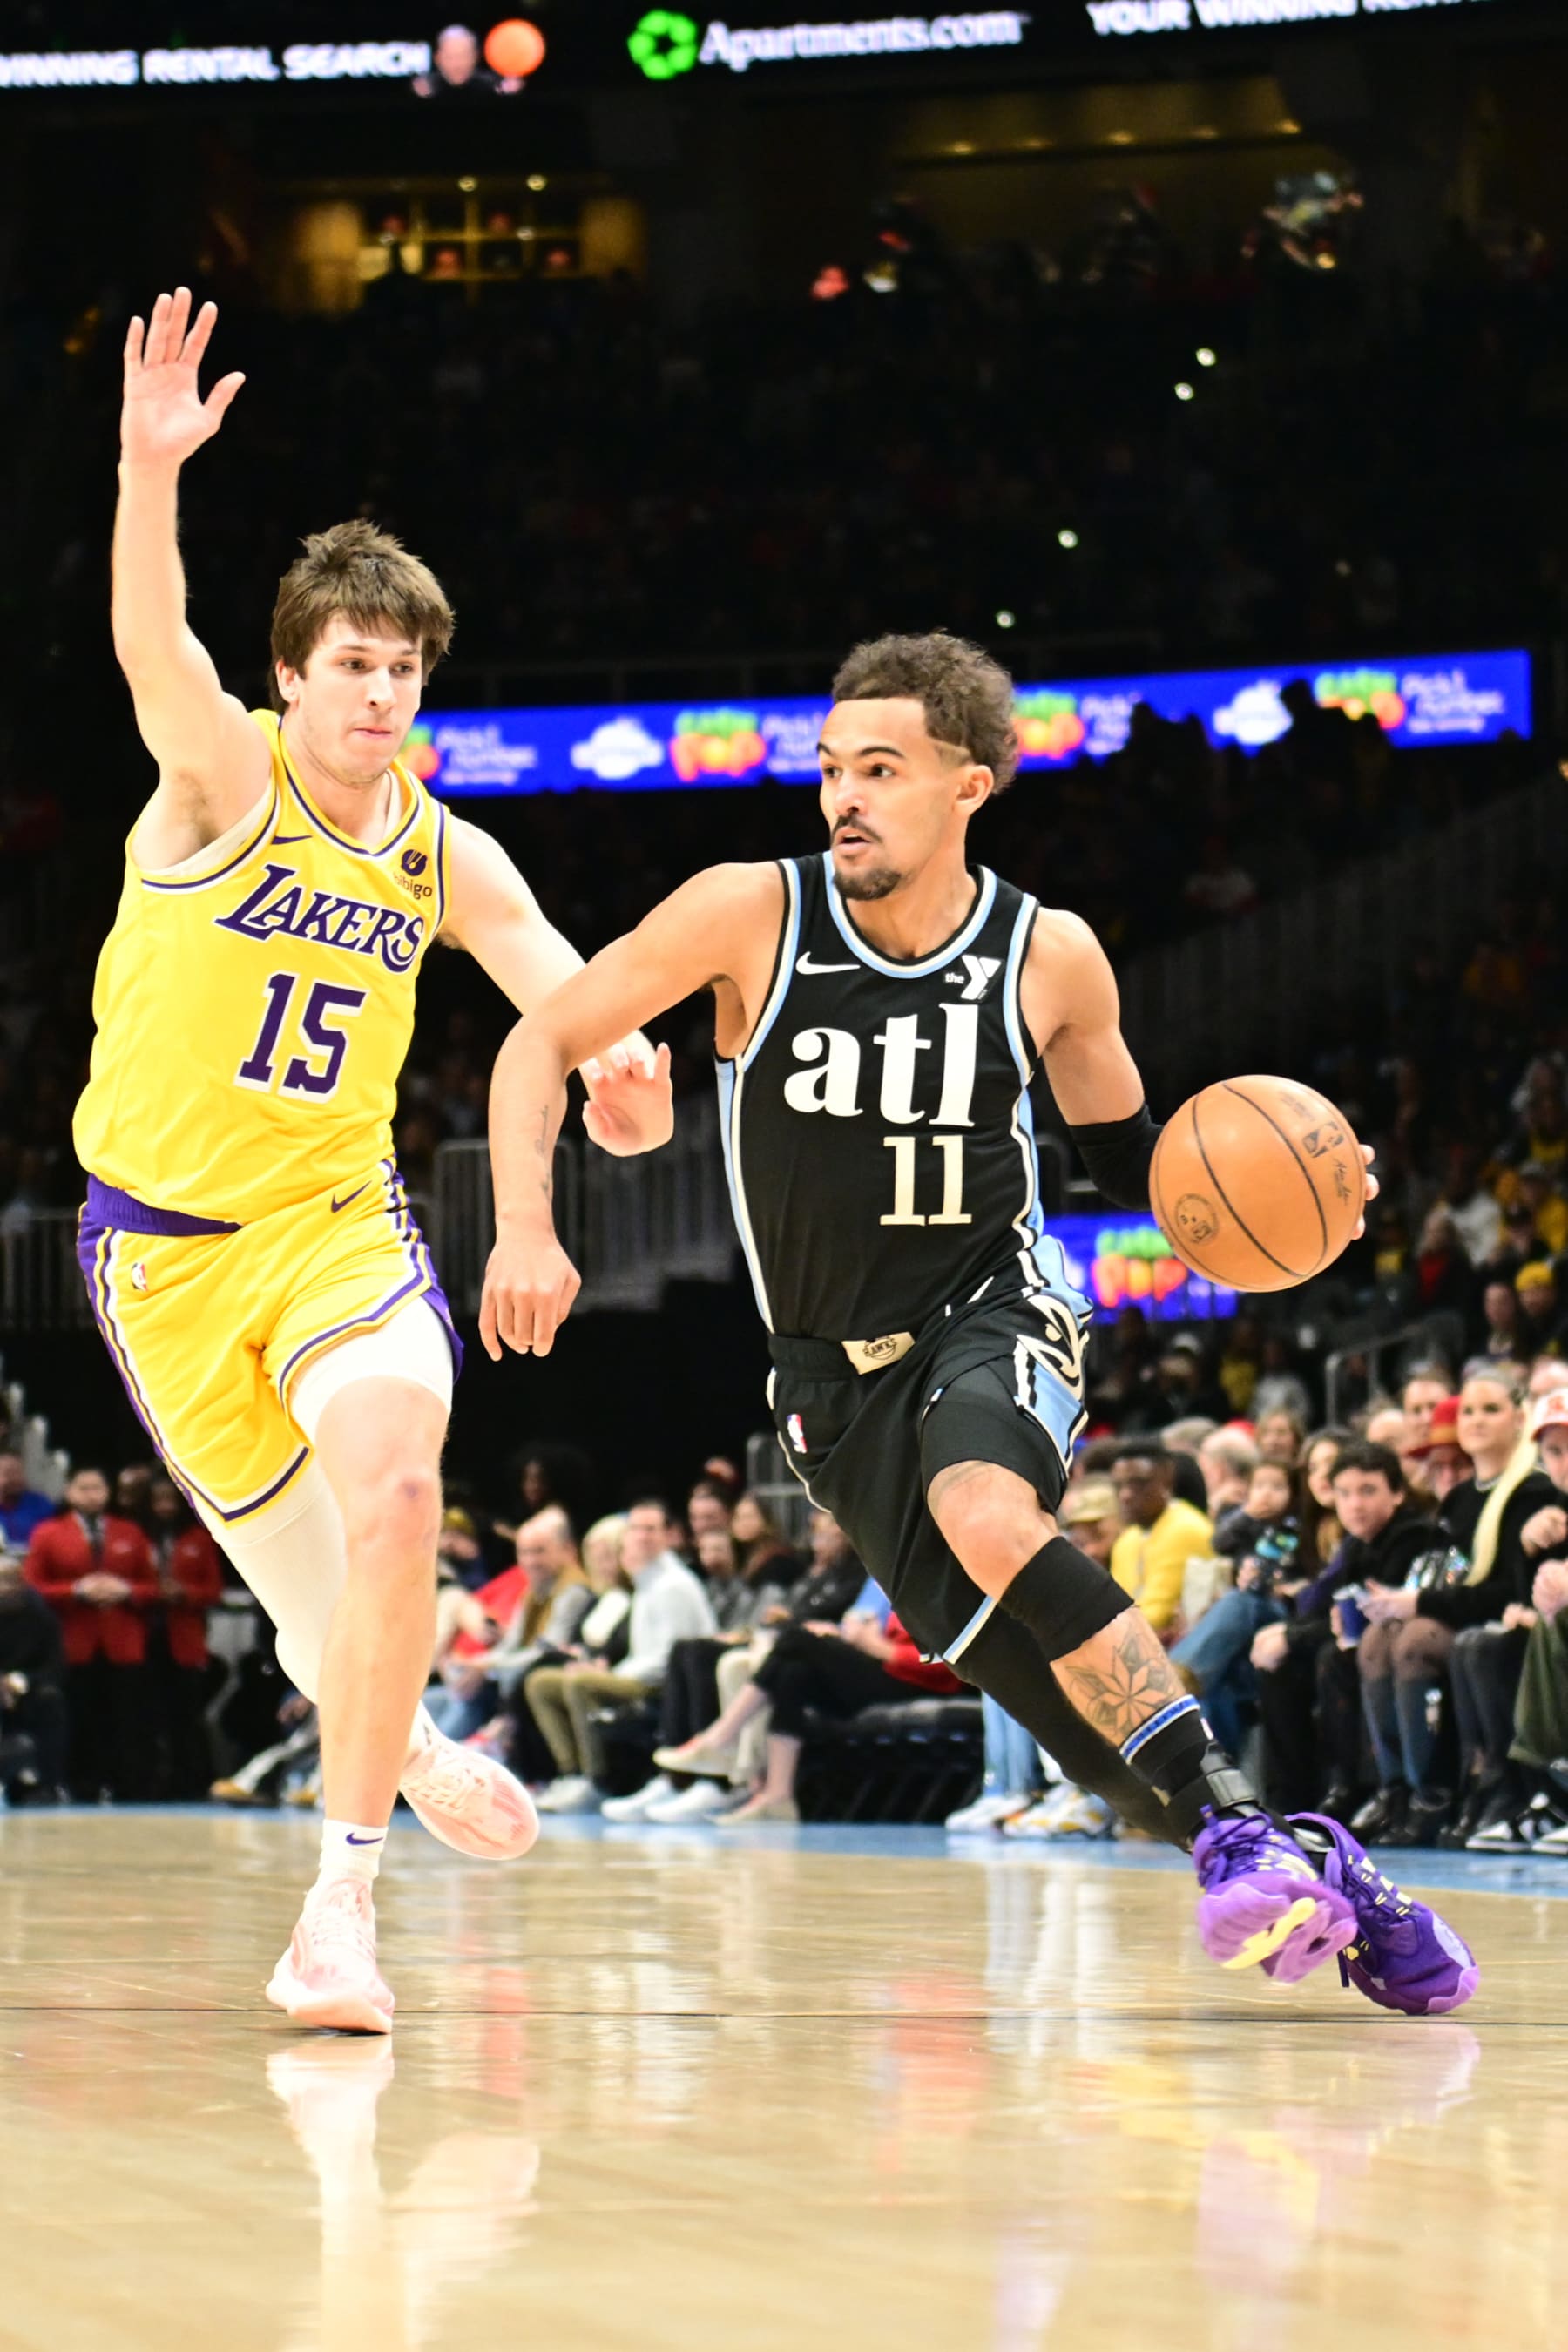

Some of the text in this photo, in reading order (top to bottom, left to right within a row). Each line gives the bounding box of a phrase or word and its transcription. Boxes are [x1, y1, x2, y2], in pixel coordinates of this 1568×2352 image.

[699, 11, 1022, 71] Apartments.com
[1086, 0, 1191, 35] YOUR
[143, 48, 280, 83] RENTAL
[284, 42, 431, 79] SEARCH
[214, 863, 425, 974] LAKERS
[944, 971, 964, 984] the
[234, 973, 367, 1103] 15
[784, 1003, 979, 1126] atl
[879, 1135, 973, 1227] 11
